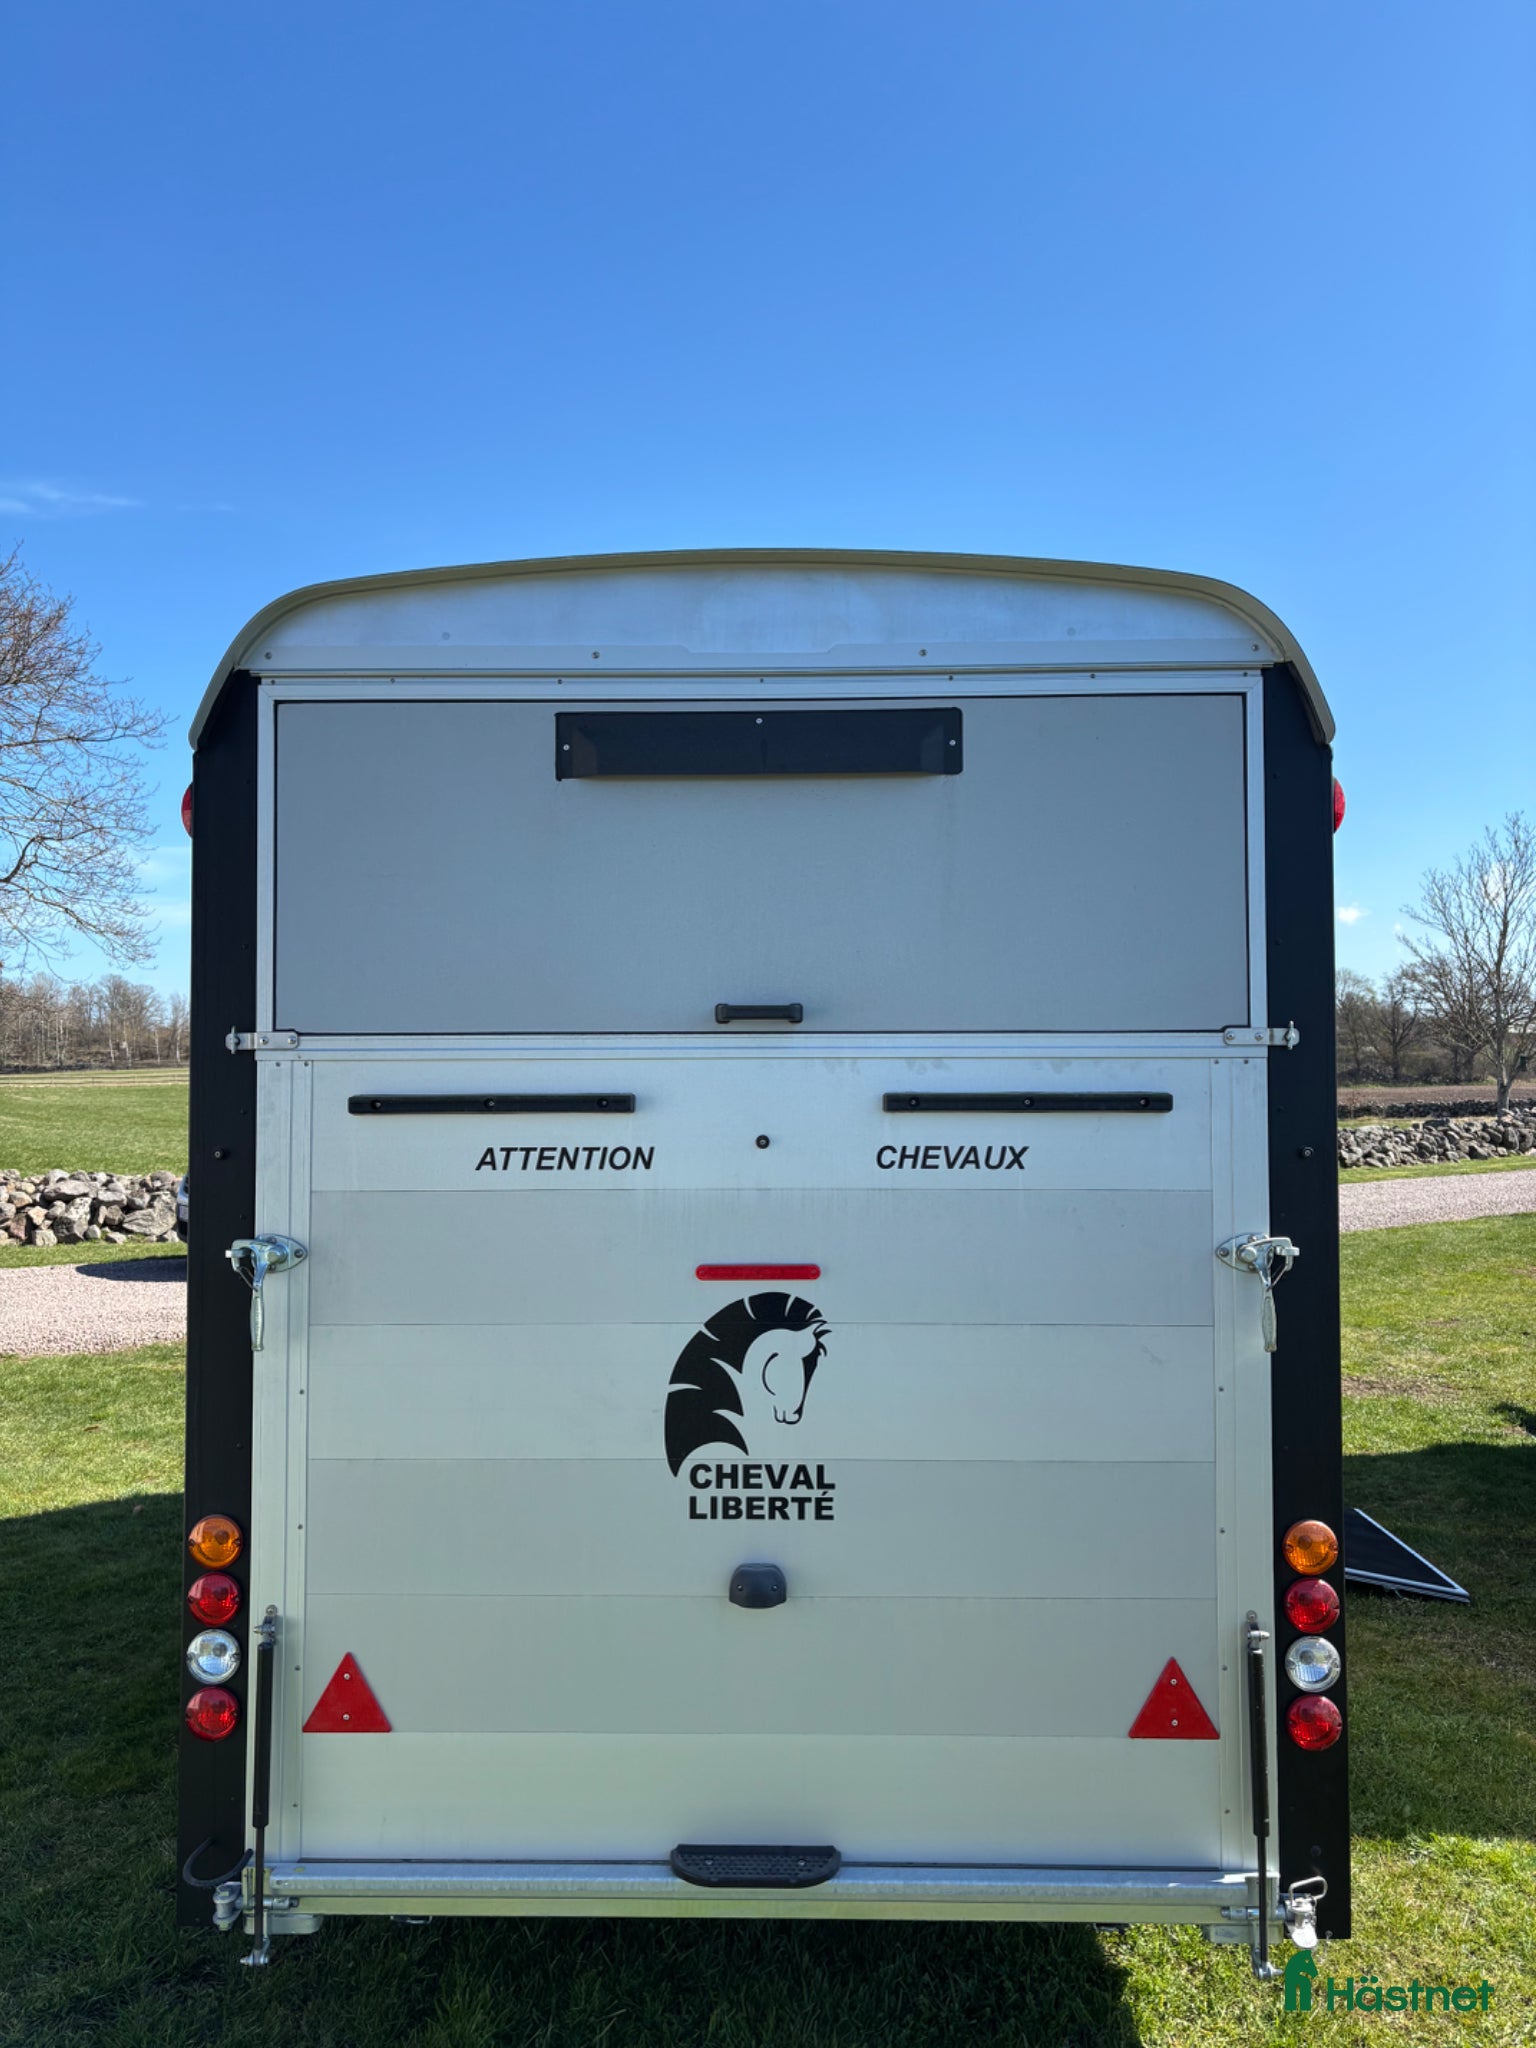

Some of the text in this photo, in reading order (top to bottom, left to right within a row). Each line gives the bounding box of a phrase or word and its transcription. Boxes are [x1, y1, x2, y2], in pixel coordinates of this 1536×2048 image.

[475, 1145, 1030, 1171] ATTENTION CHEVAUX
[689, 1463, 836, 1490] CHEVAL
[689, 1491, 835, 1521] LIBERTÉ
